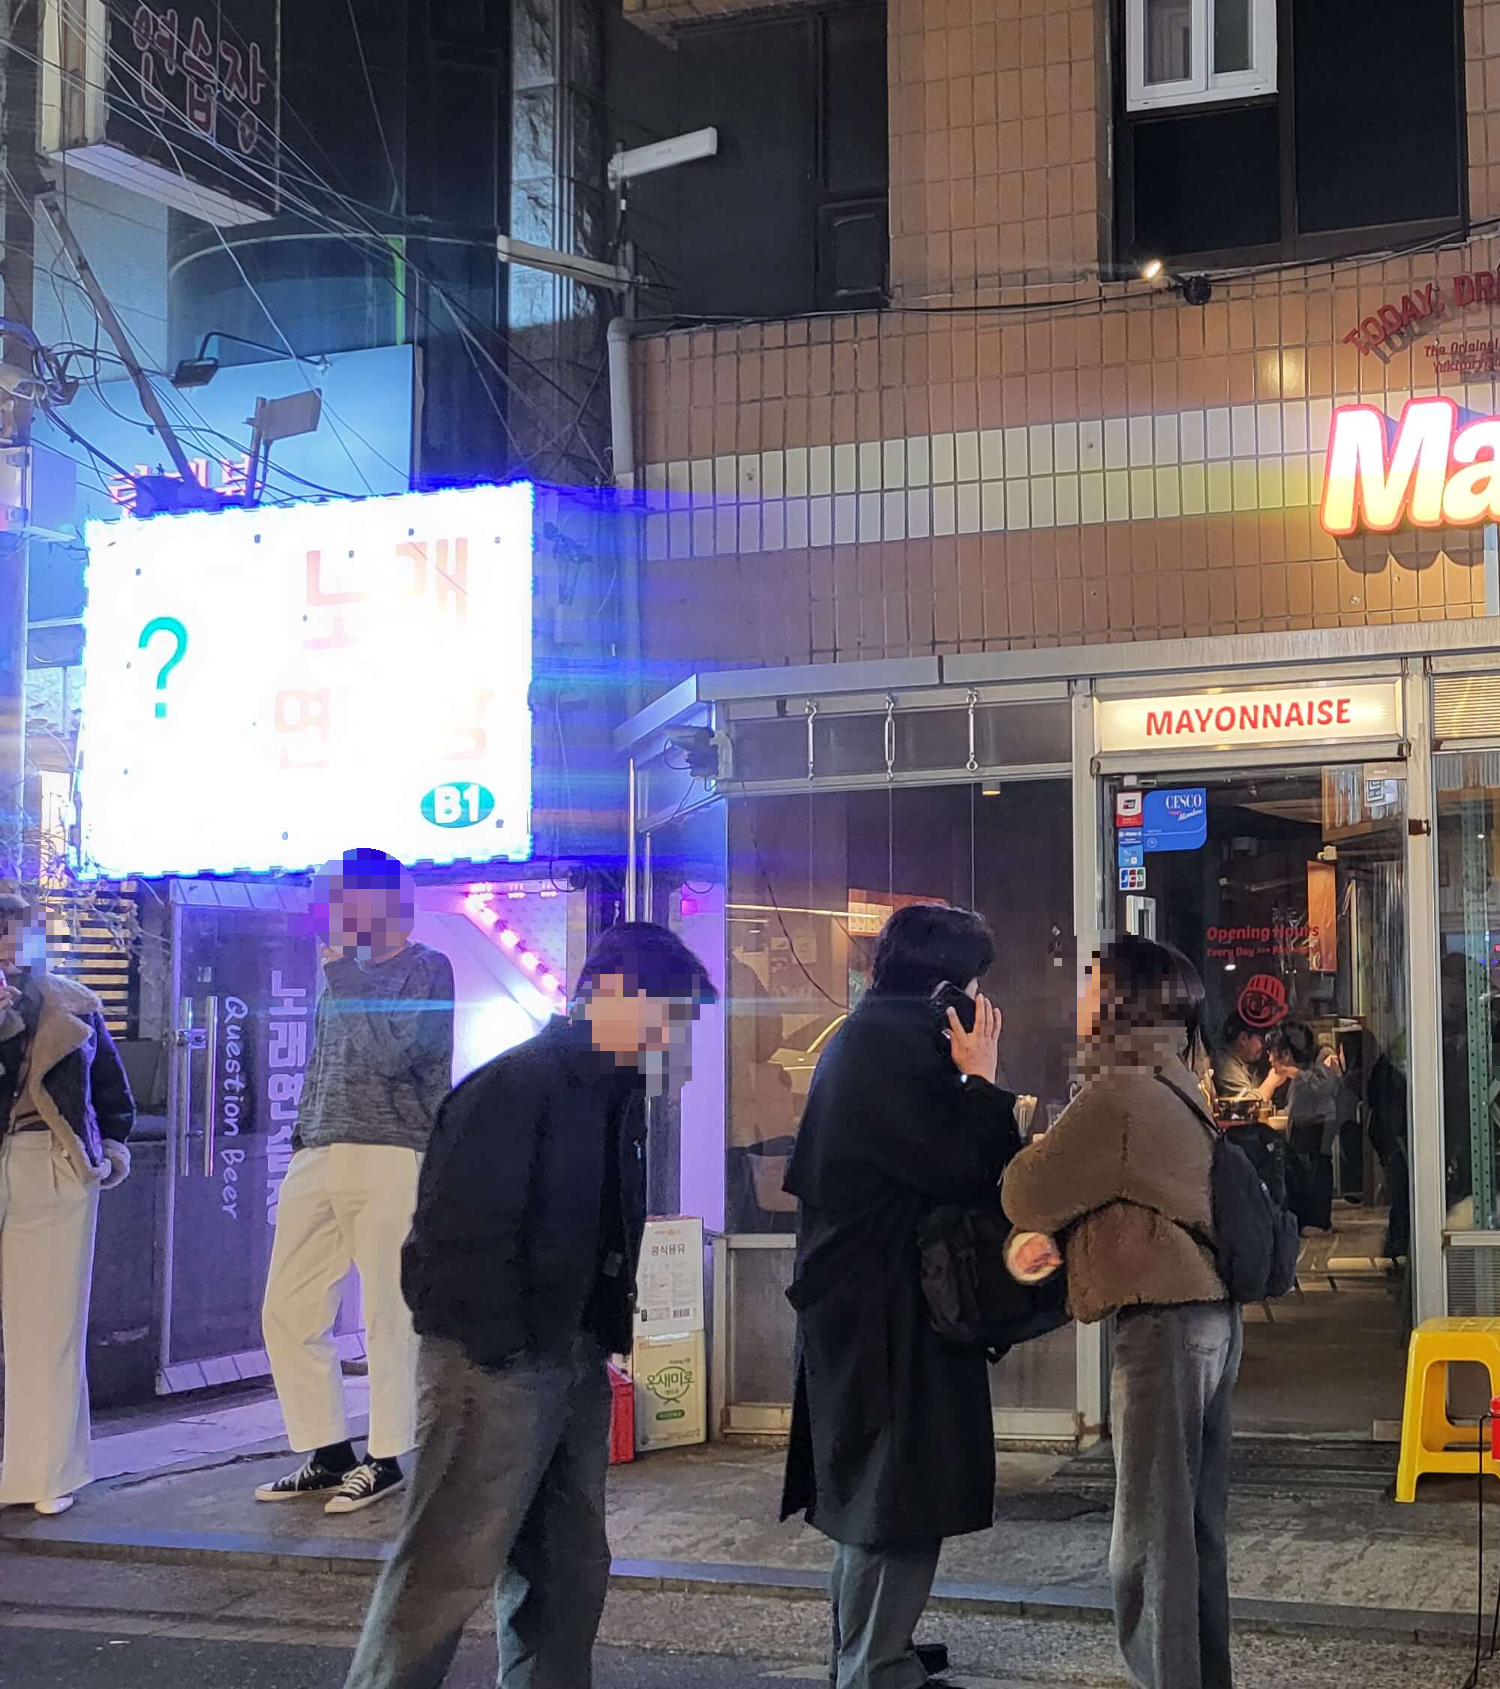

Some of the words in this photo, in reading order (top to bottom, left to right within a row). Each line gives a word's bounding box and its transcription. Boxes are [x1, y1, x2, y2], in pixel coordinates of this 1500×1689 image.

[133, 6, 266, 154] 연습장
[1424, 345, 1446, 358] The
[1450, 338, 1499, 355] Original
[1145, 697, 1352, 737] MAYONNAISE
[432, 785, 482, 825] B1
[1165, 793, 1203, 810] CESCO
[1206, 925, 1271, 943] Opening
[1272, 924, 1320, 940] Hours
[1206, 947, 1235, 958] Every
[1235, 946, 1255, 958] Day
[223, 996, 249, 1137] Question
[220, 1148, 245, 1220] Beer
[645, 1370, 695, 1391] 온새미로
